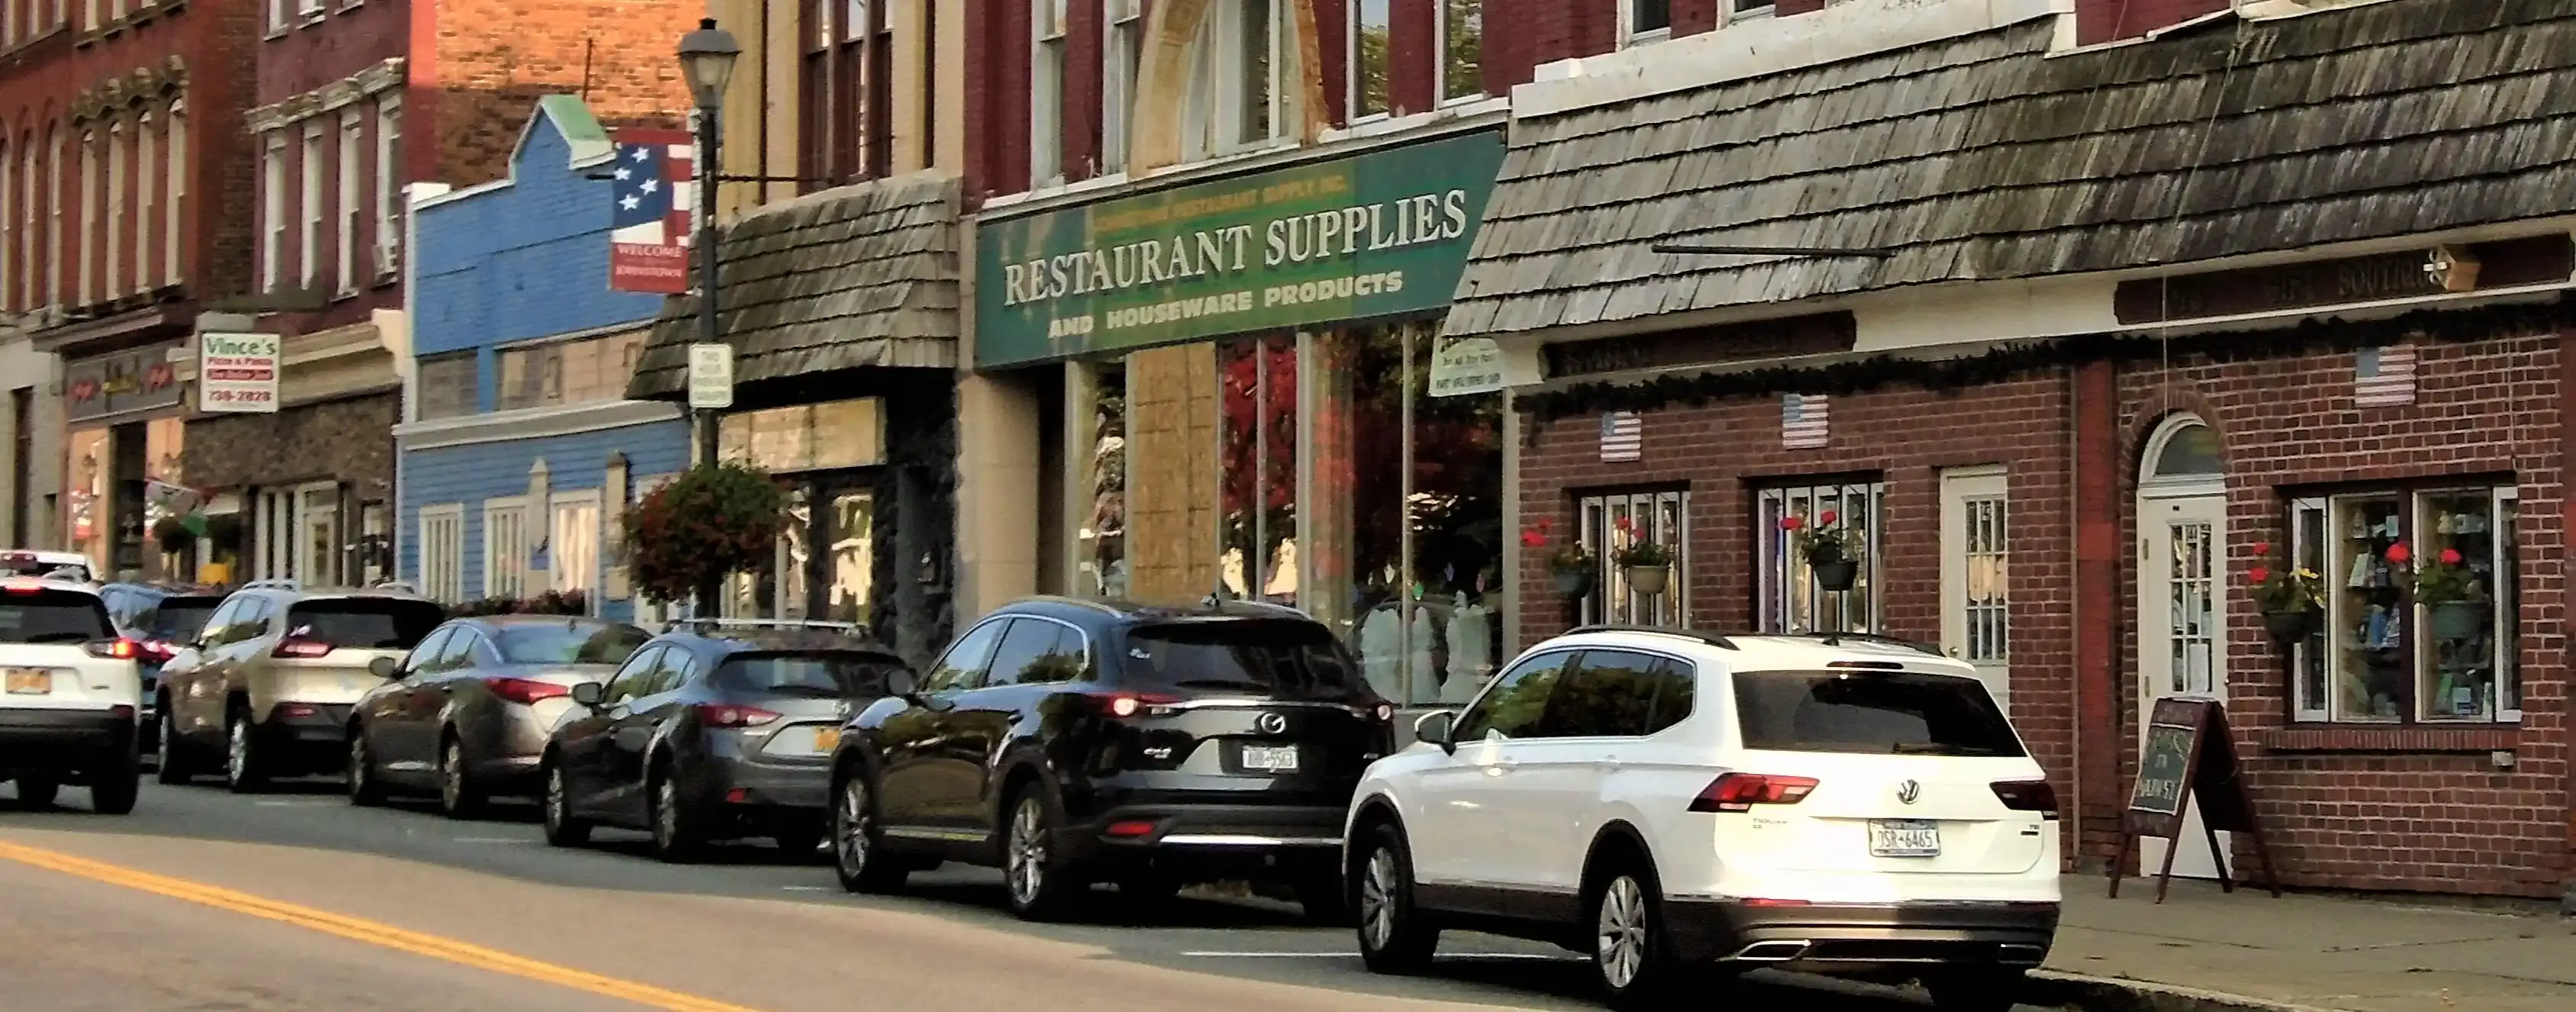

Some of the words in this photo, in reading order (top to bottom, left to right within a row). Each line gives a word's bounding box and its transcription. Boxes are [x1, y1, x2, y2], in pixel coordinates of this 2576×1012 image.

[617, 244, 682, 257] WELCOME
[1004, 224, 1253, 306] RESTAURANT
[1265, 189, 1466, 266] SUPPLIES
[1048, 314, 1094, 339] AND
[1107, 290, 1253, 330] HOUSEWARE
[1264, 270, 1403, 308] PRODUCTS
[205, 337, 276, 356] Vince's
